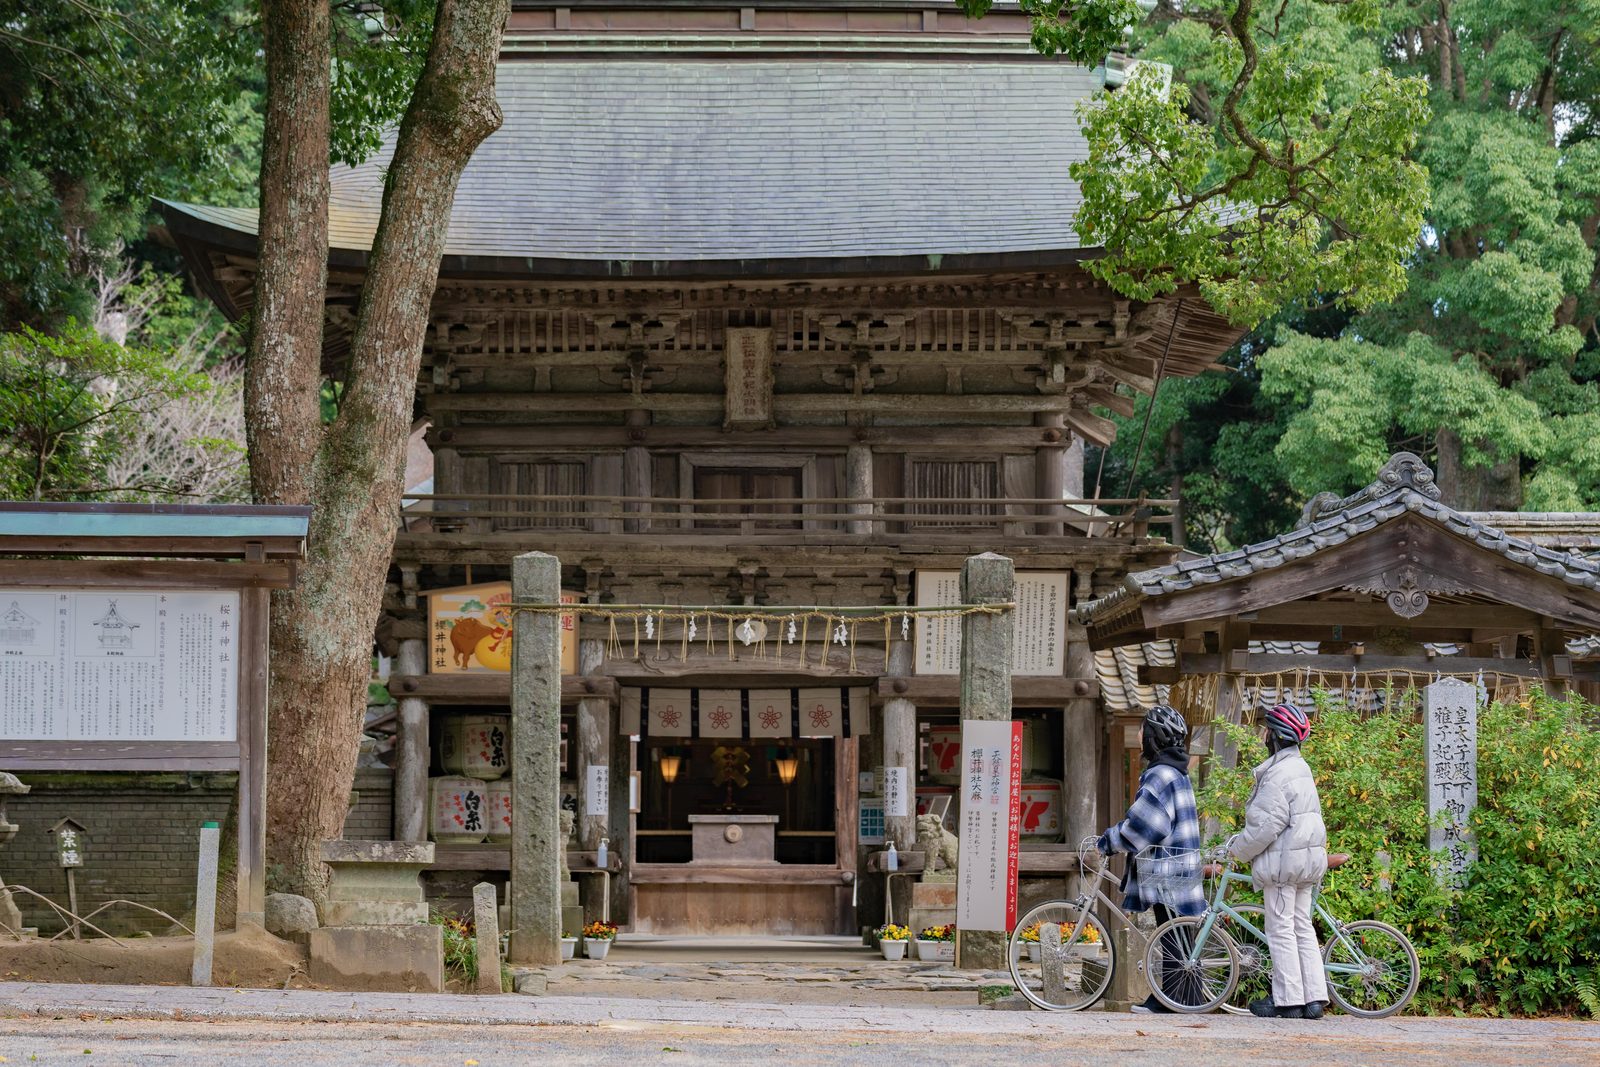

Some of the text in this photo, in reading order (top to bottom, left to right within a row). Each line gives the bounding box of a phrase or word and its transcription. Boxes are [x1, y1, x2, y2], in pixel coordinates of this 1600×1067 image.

[219, 604, 231, 663] 桜井神社
[1433, 706, 1454, 799] 雅子妃殿下
[1453, 706, 1473, 799] 皇太子殿下
[890, 769, 898, 814] 境内お静かに
[1008, 735, 1021, 913] あなたのお部屋にお神様をお迎えしましょう
[60, 829, 79, 865] 禁煙
